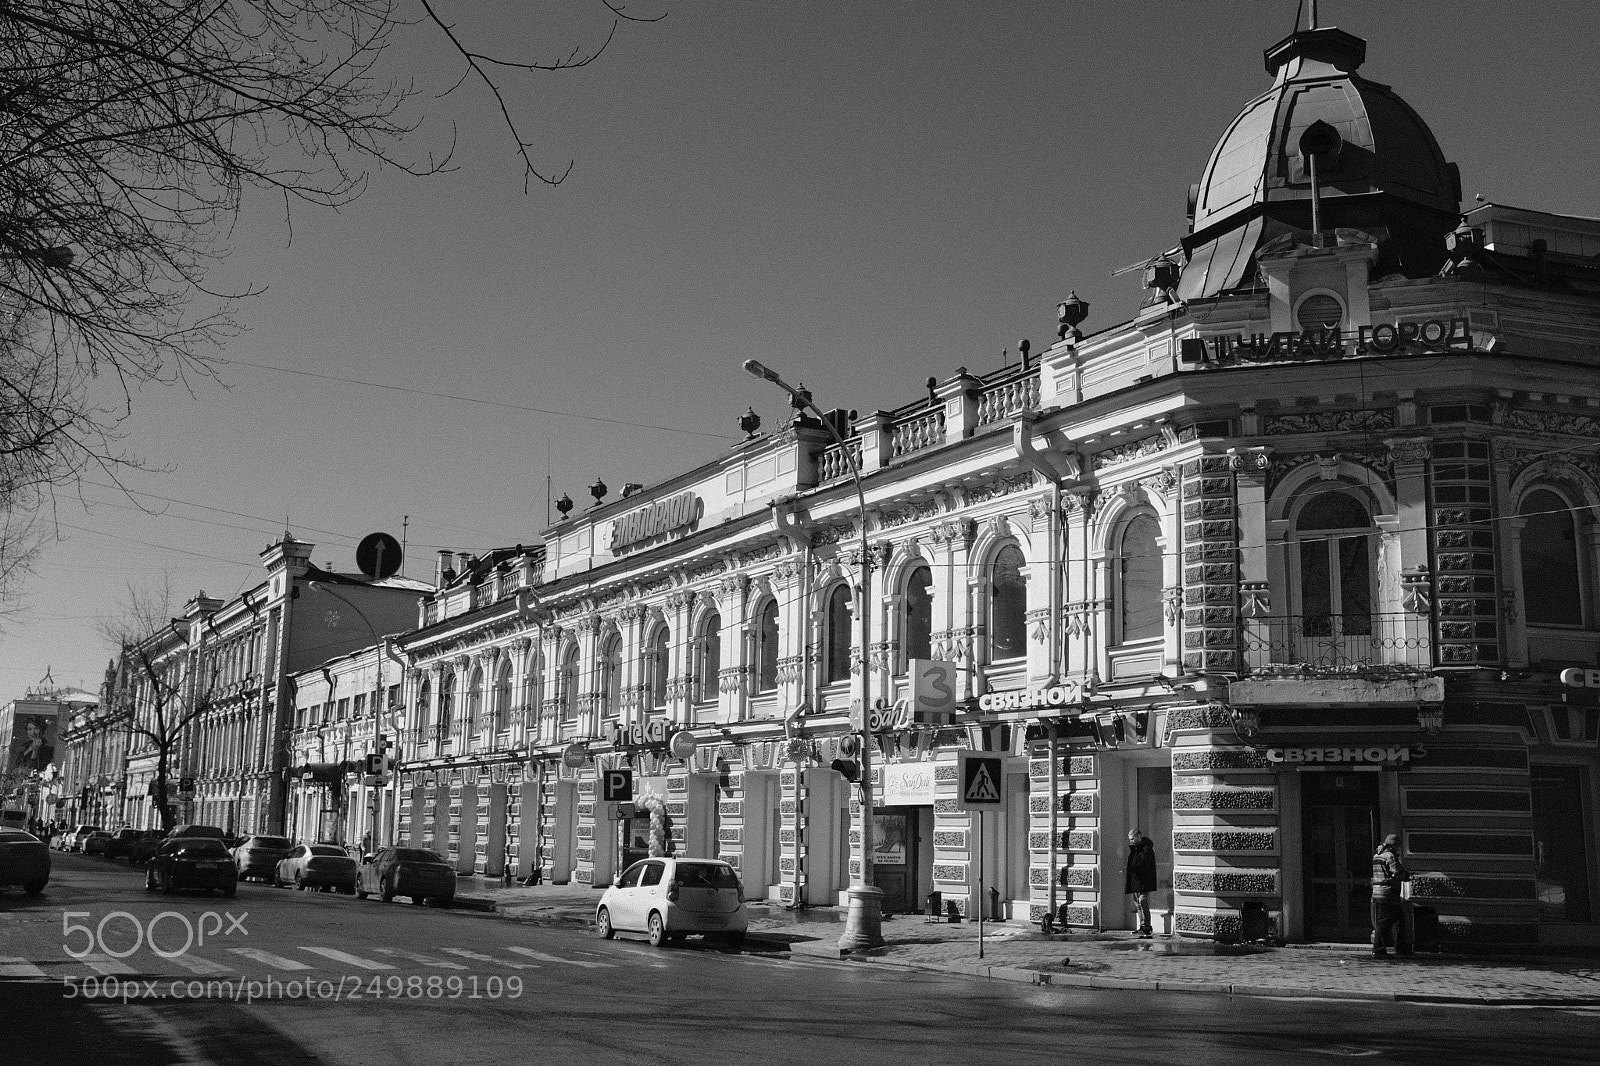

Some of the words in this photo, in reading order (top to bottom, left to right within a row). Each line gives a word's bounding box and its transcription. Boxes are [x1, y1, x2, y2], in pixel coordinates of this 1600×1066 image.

[1356, 317, 1473, 355] ГОРОД
[979, 681, 1084, 712] СВЯЗНОЙ
[1266, 746, 1410, 763] СВЯЗНОЙ
[609, 772, 626, 799] P
